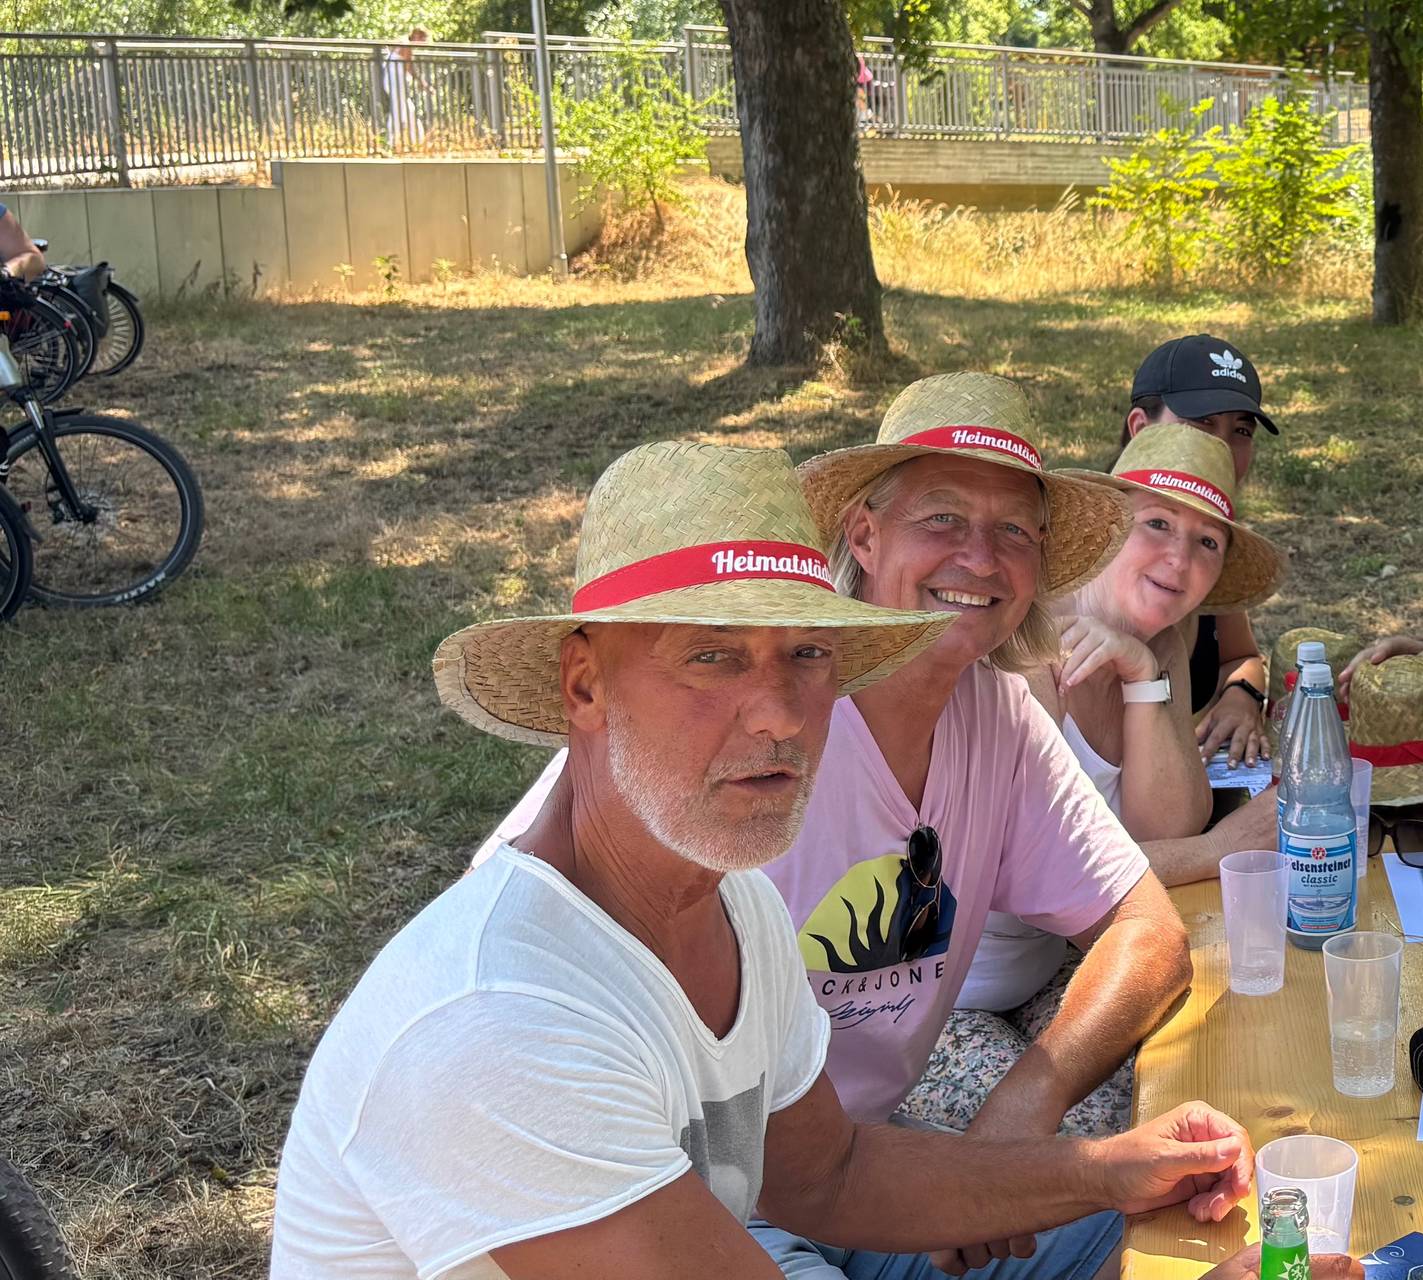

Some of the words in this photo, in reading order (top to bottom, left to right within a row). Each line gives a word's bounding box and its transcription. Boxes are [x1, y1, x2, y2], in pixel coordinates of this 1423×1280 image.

[1211, 368, 1247, 383] adidas
[1290, 858, 1351, 873] elsensteiner
[1301, 874, 1338, 884] classic
